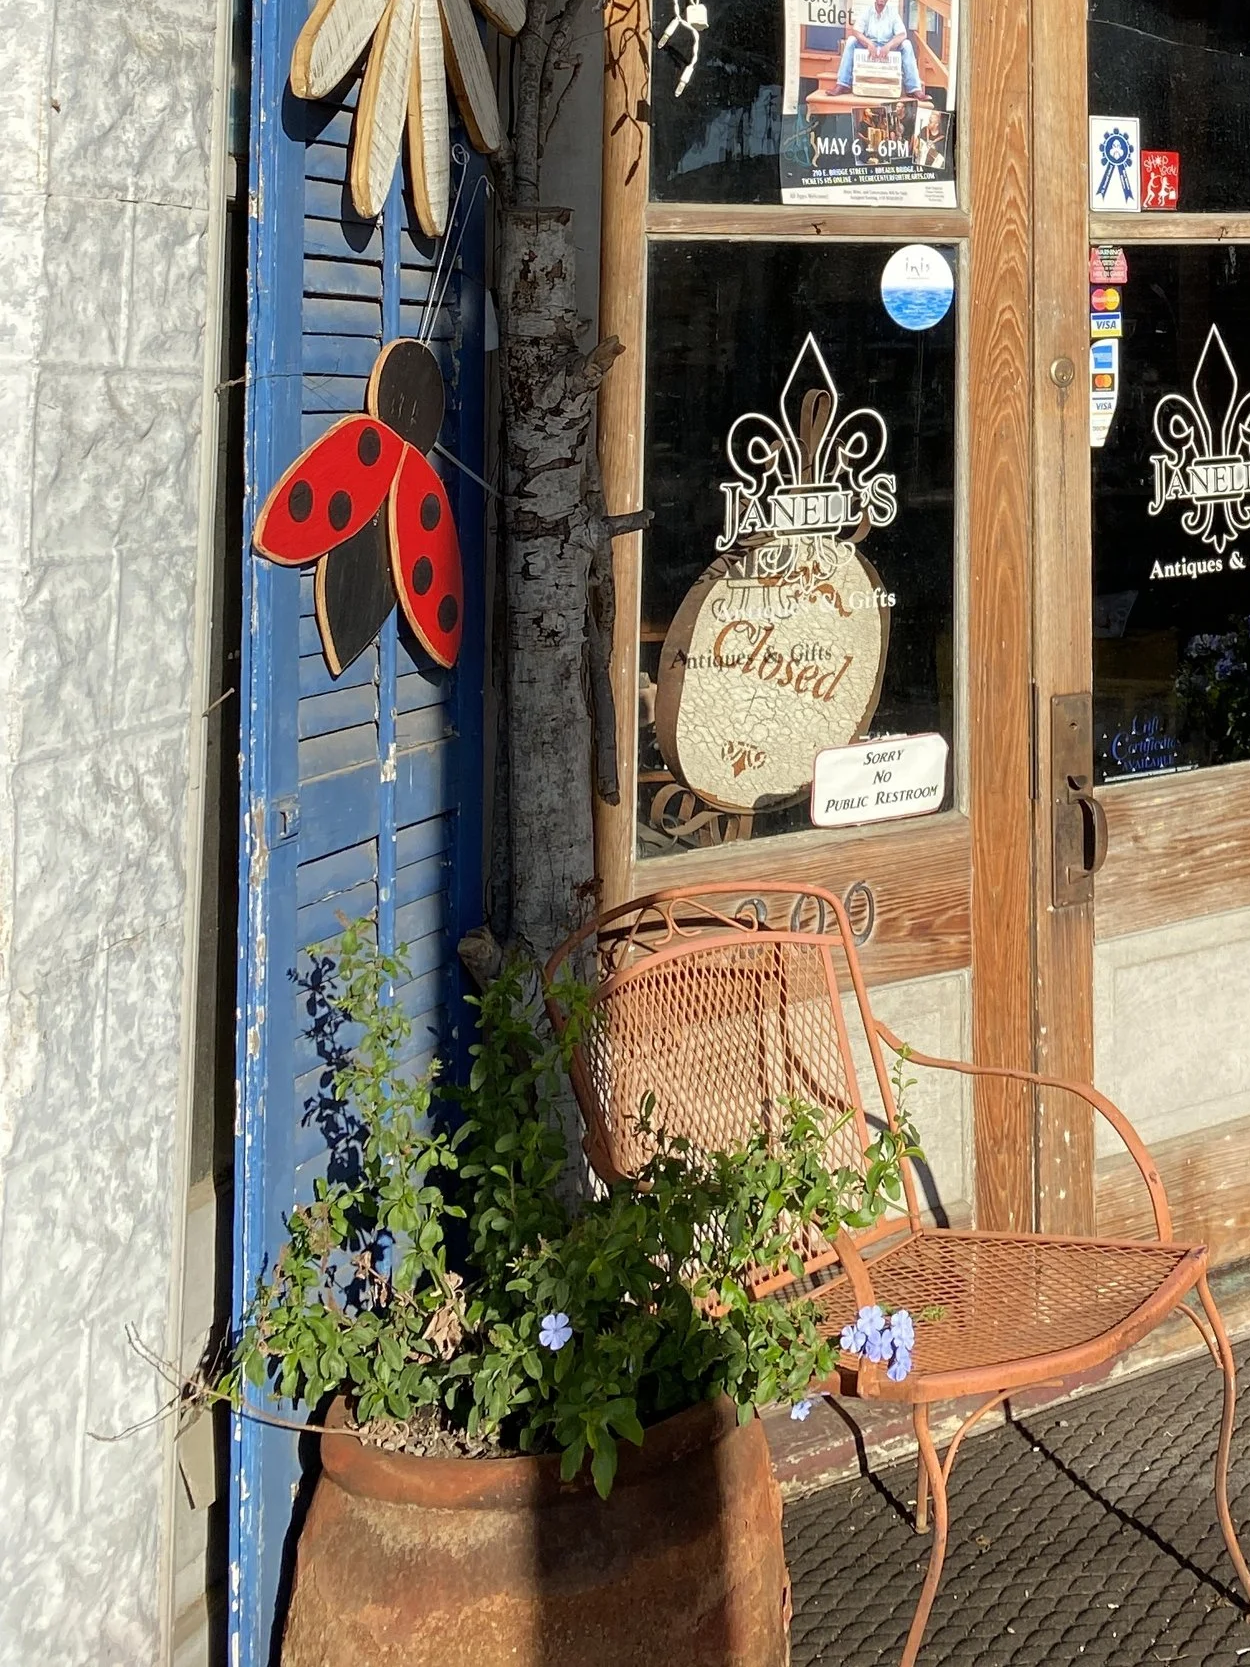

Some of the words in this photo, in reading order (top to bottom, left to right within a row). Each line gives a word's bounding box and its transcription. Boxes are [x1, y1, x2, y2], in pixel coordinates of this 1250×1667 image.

[808, 2, 856, 26] Ledet
[816, 136, 848, 156] MAY
[851, 138, 862, 156] 6
[877, 139, 910, 158] 6PM
[1096, 320, 1117, 330] VISA
[1095, 402, 1112, 411] VISA
[715, 473, 897, 551] JANELL'S
[1149, 556, 1223, 580] Antiques
[1228, 550, 1246, 570] &
[848, 586, 897, 610] Gifts
[712, 619, 854, 703] Closed
[863, 749, 905, 766] SORRY
[872, 769, 893, 785] NO
[824, 795, 870, 813] PUBLIC
[874, 784, 939, 806] RESTROOM
